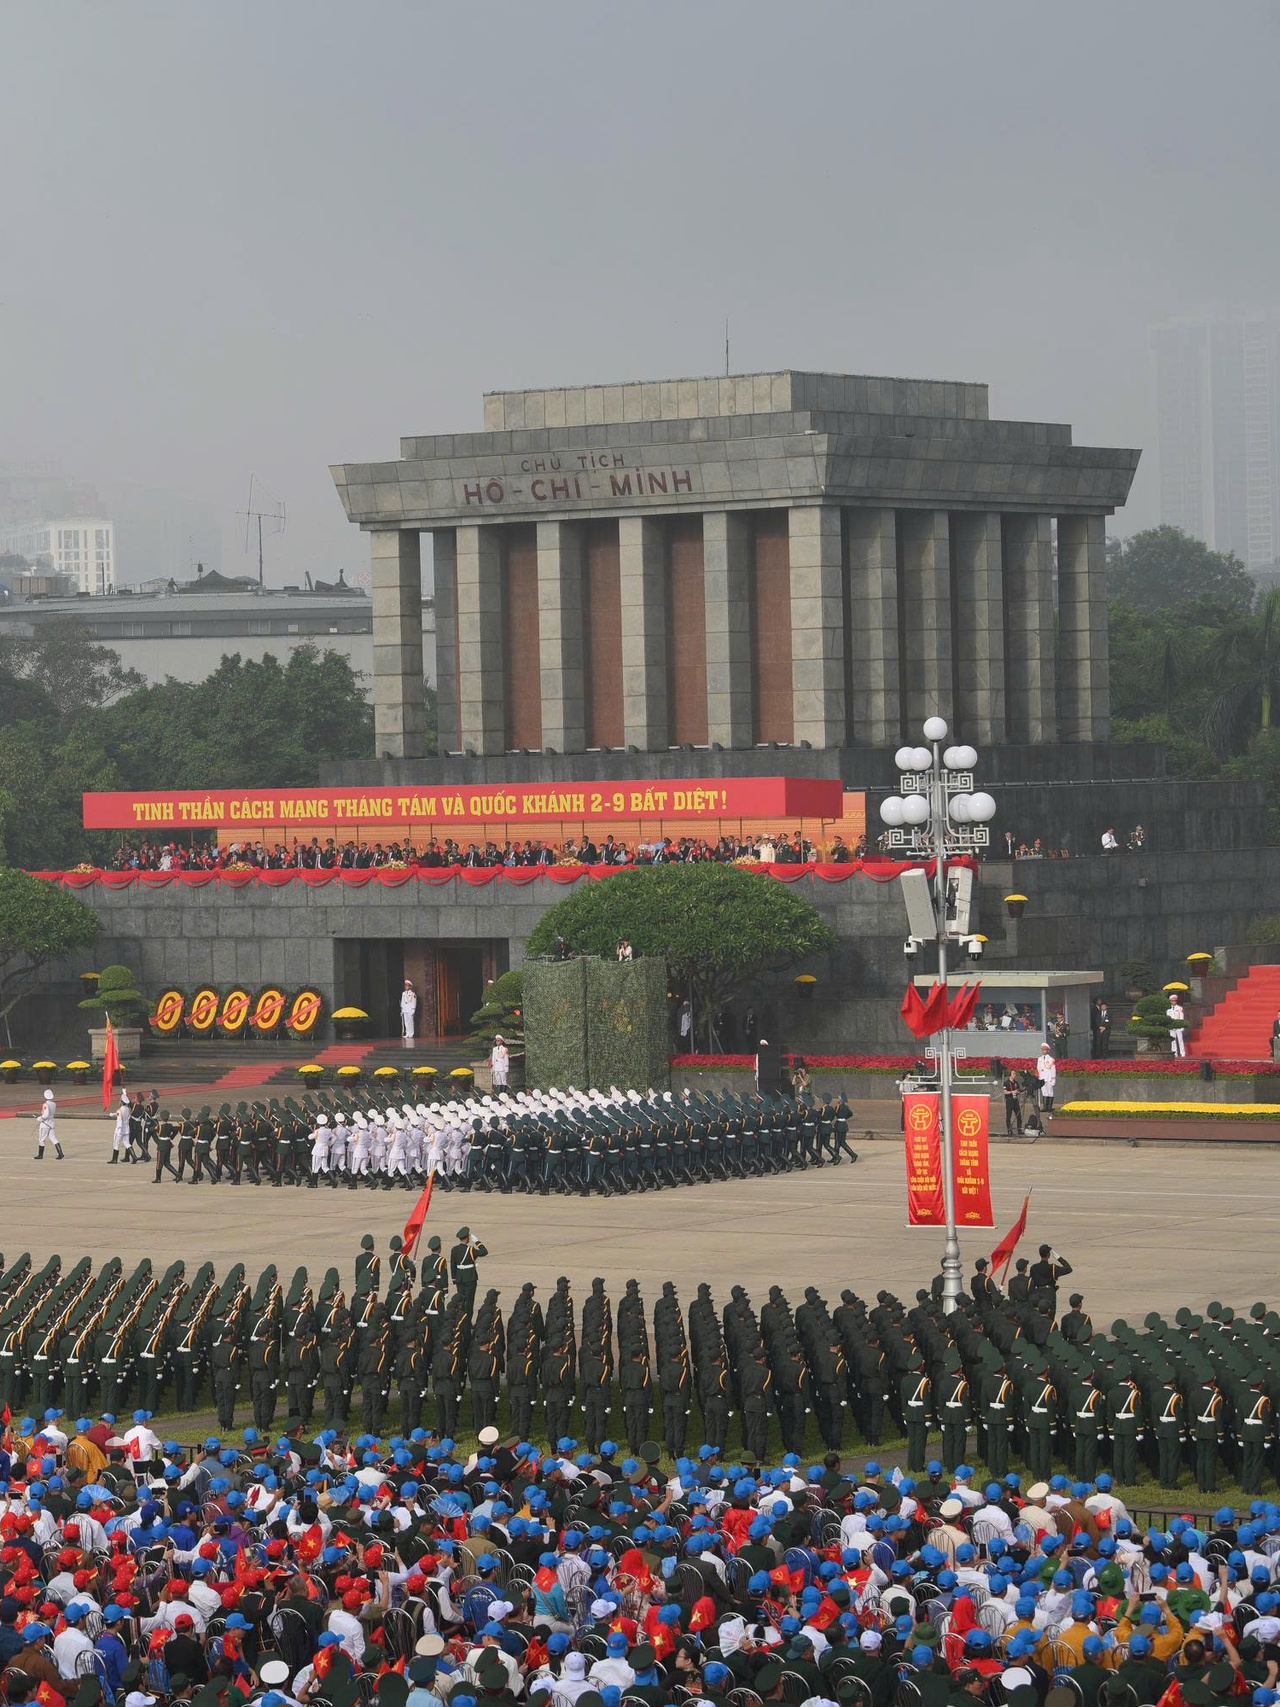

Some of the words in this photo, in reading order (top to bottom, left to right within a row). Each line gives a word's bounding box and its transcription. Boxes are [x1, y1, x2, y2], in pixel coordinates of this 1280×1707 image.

[133, 802, 174, 821] TINH
[178, 795, 225, 820] THẦN
[230, 797, 275, 819] CÁCH
[280, 799, 329, 822] MẠNG
[334, 795, 393, 818] THÁNG
[398, 794, 437, 816] TÁM
[442, 792, 465, 815] VÀ
[470, 790, 517, 816] QUỐC
[523, 791, 585, 814] KHÁNH
[591, 792, 625, 813] 2-9
[630, 786, 668, 812] BẤT
